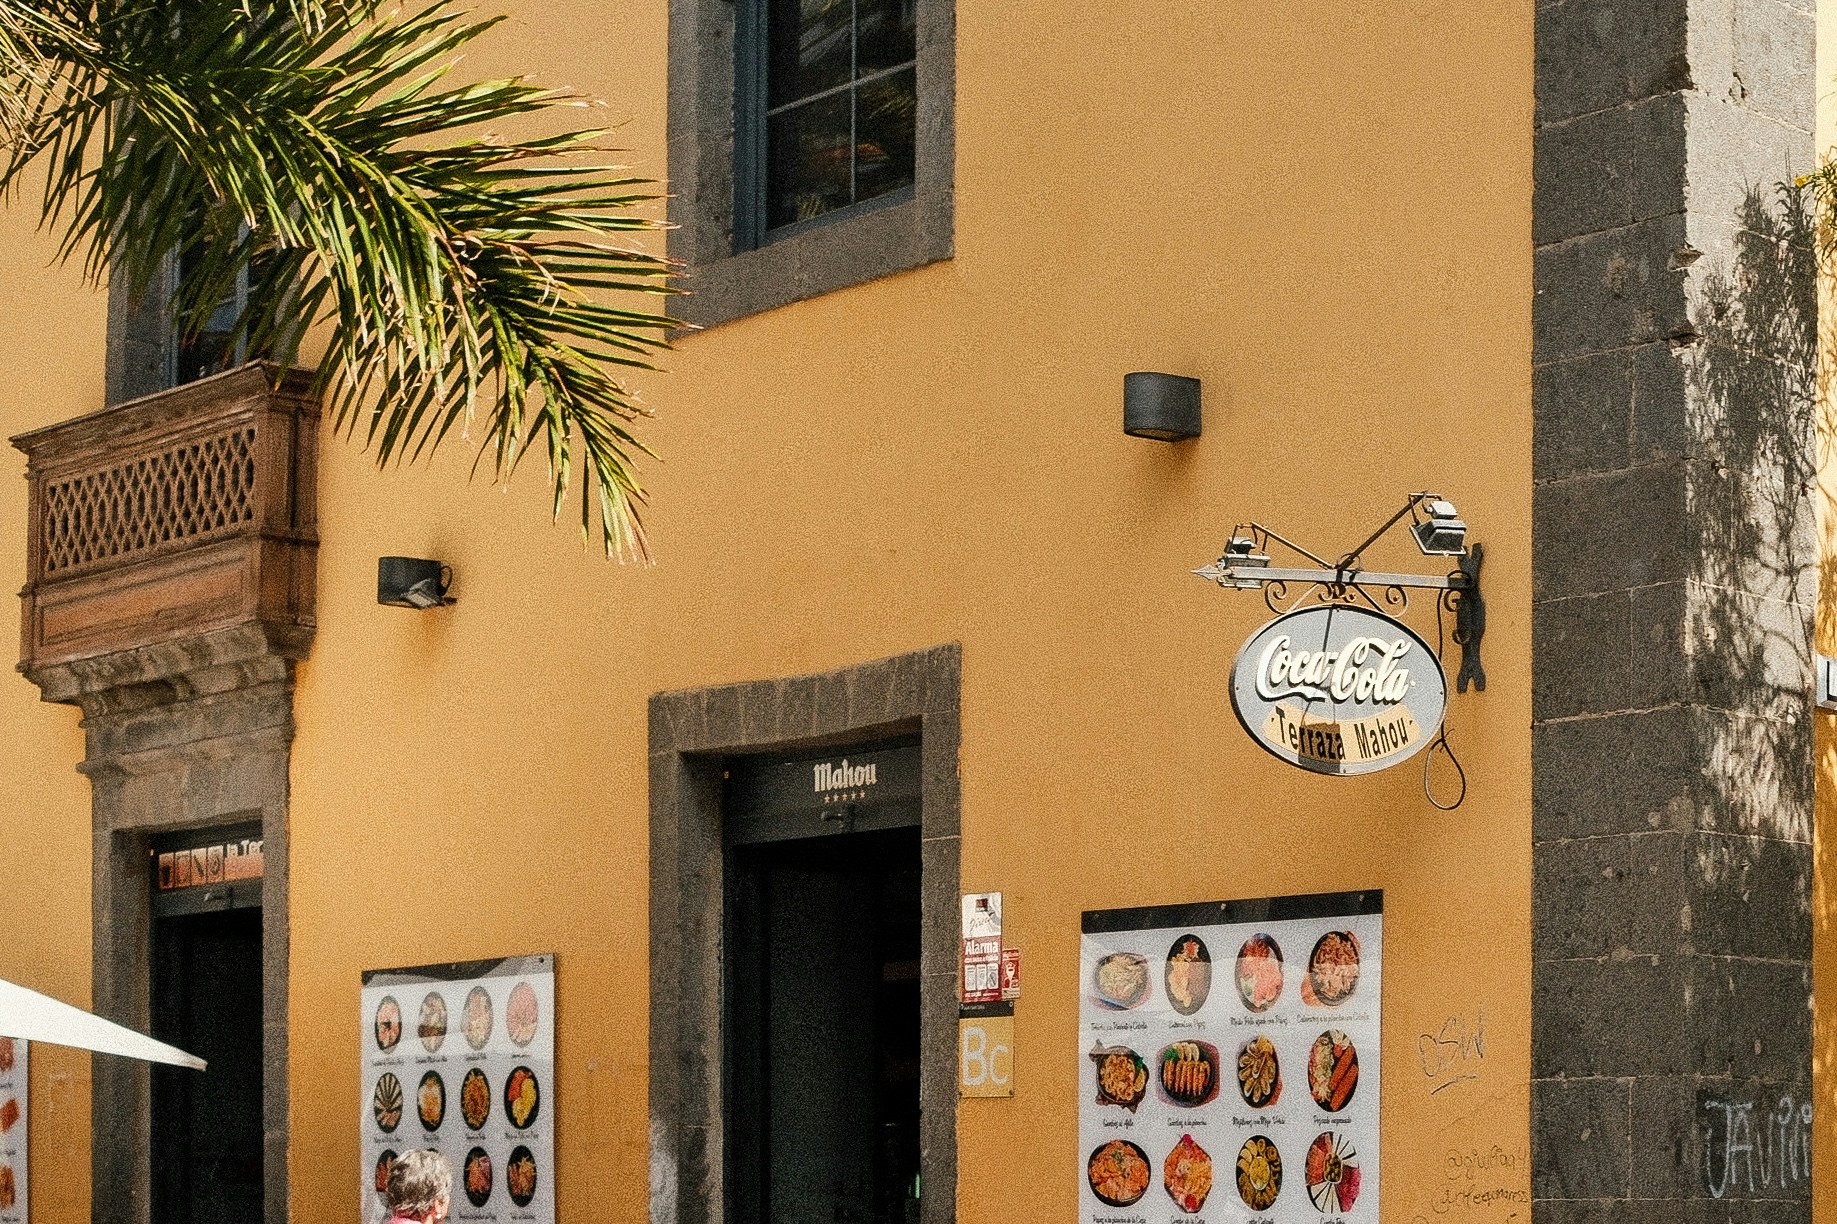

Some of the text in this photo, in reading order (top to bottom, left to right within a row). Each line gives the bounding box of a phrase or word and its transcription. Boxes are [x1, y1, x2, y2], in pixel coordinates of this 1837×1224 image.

[1255, 633, 1414, 704] Coca-Cola
[1275, 705, 1409, 760] Terraza Mahou
[813, 759, 878, 793] Mahou
[965, 941, 999, 956] Alarma
[961, 1025, 1010, 1087] Bc
